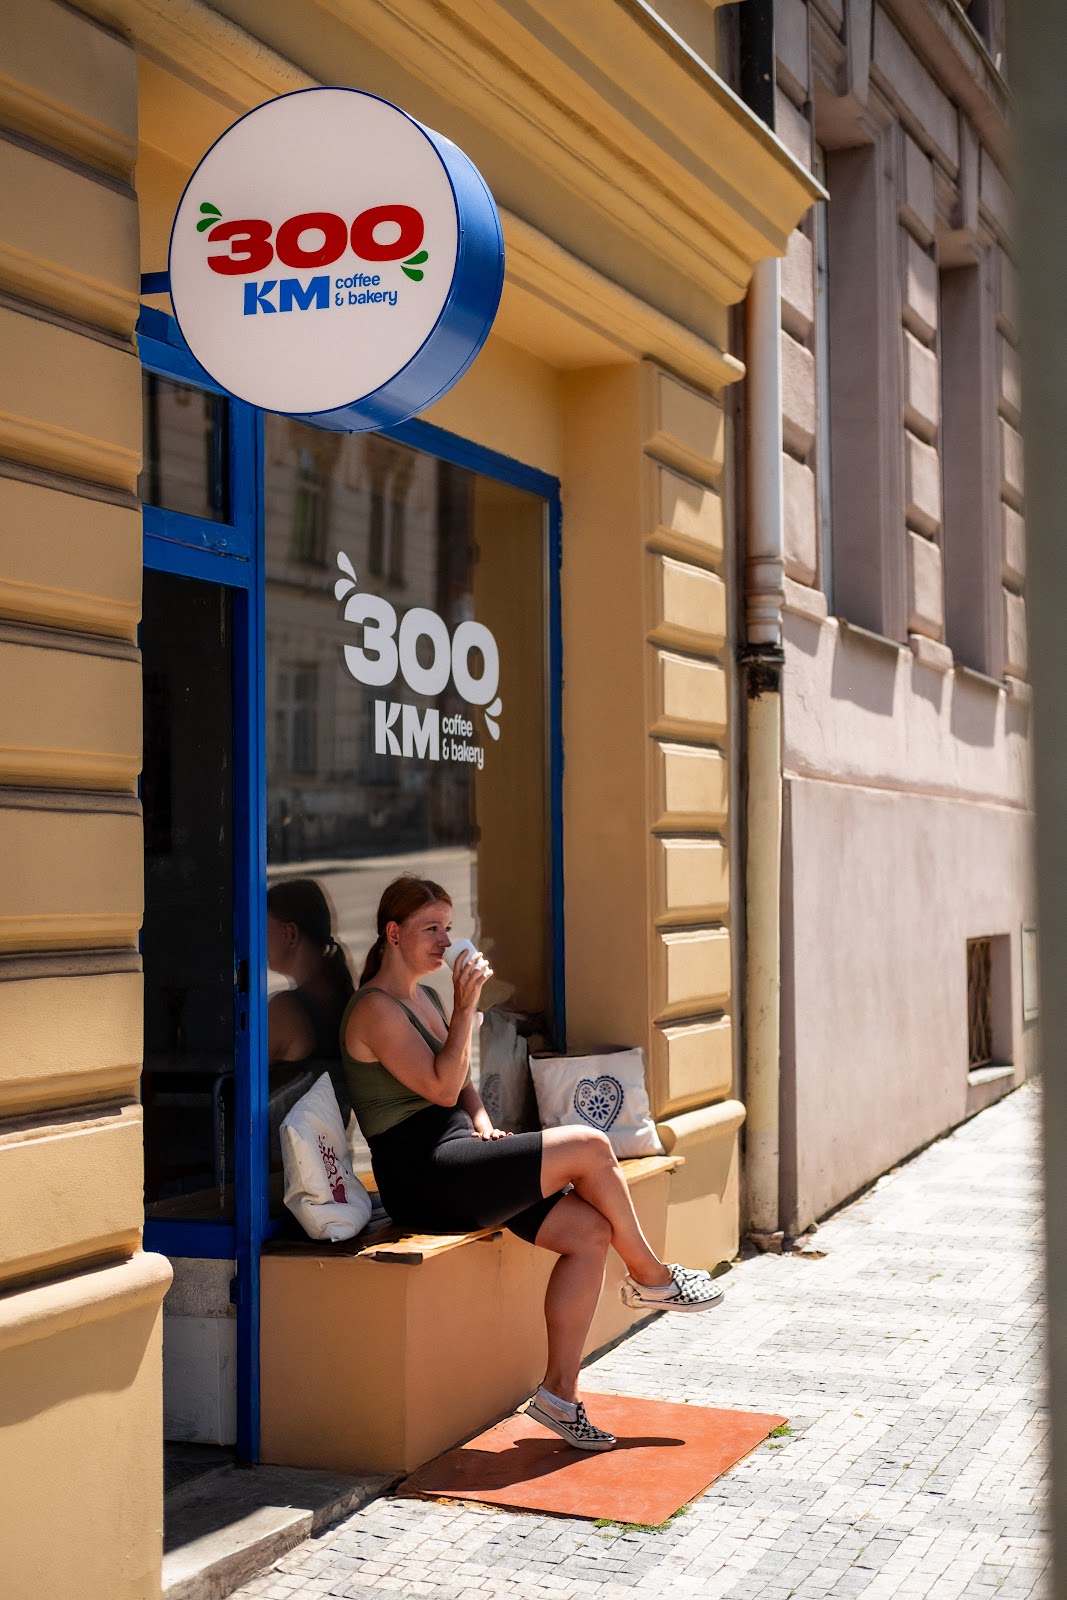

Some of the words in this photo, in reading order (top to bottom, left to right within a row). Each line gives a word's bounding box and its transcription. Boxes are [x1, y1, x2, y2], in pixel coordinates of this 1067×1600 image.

[207, 204, 424, 275] 300
[243, 275, 330, 315] KM
[335, 273, 380, 289] coffee
[335, 292, 344, 306] &
[348, 289, 398, 306] bakery
[344, 593, 499, 705] 300
[375, 700, 440, 761] KM
[442, 714, 473, 737] coffee
[442, 738, 450, 760] &
[451, 738, 484, 770] bakery
